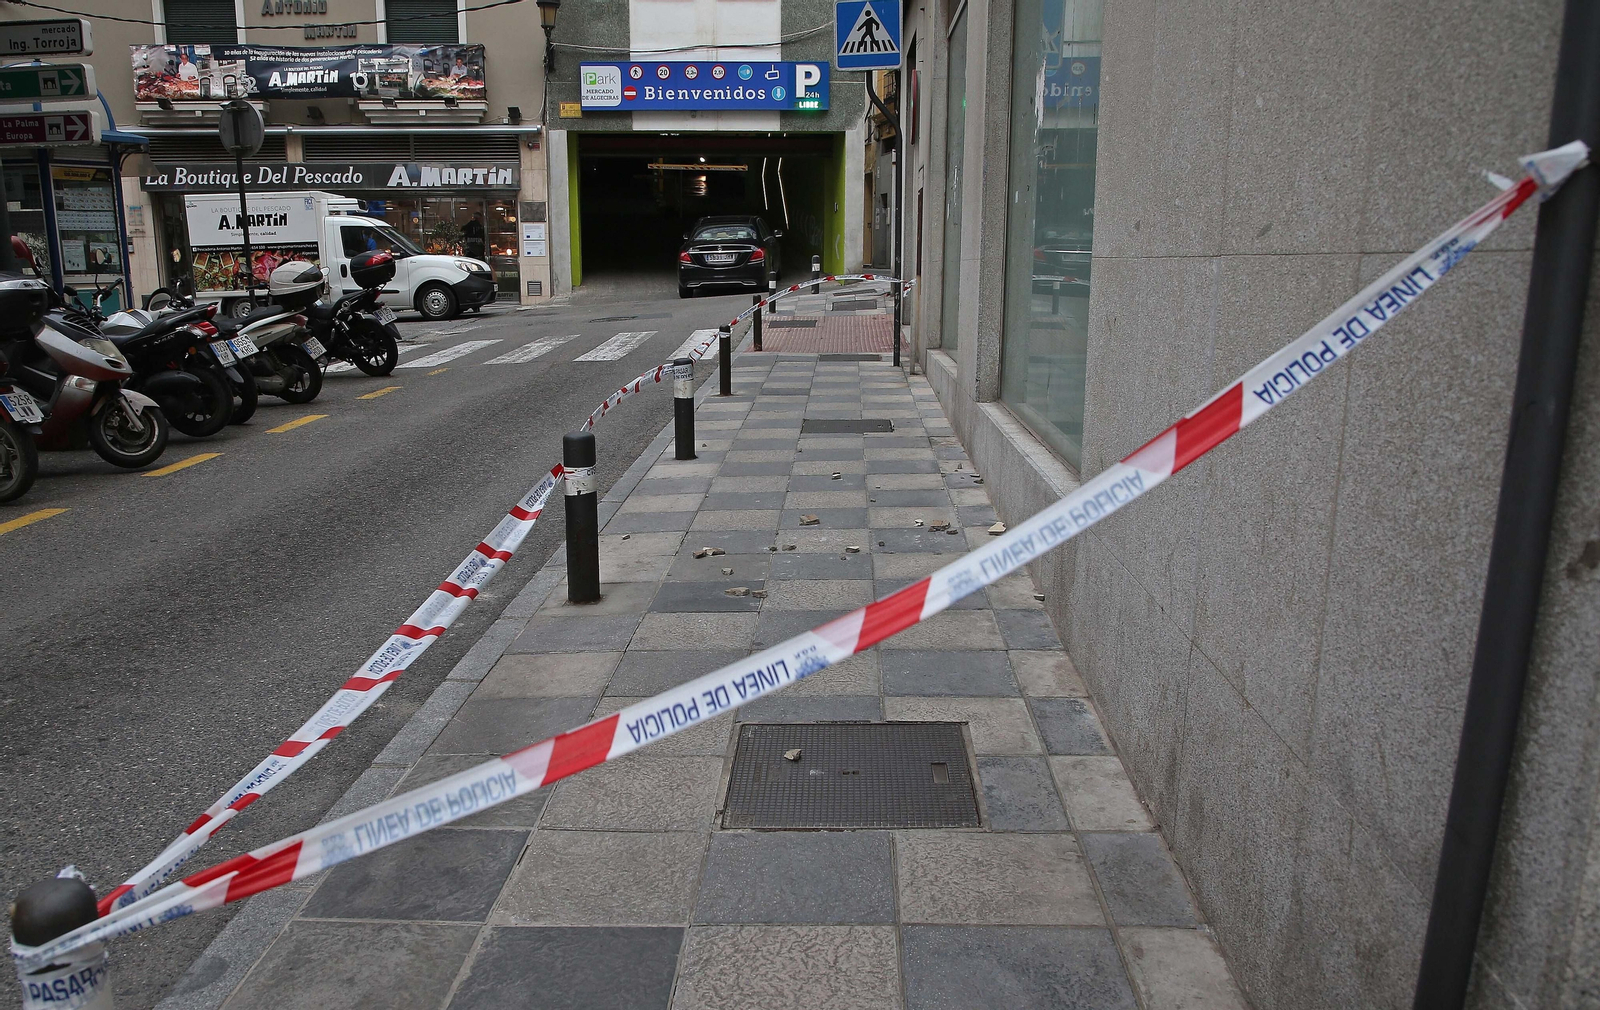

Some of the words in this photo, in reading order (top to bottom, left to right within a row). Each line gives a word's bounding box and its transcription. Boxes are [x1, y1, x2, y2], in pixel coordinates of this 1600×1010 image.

[42, 25, 76, 34] mercado
[9, 39, 30, 51] Ing.
[33, 37, 77, 50] Torroja
[583, 72, 616, 85] iPark
[644, 86, 766, 100] Bienvenidos
[6, 132, 33, 140] Europa
[174, 167, 252, 188] Boutique
[257, 166, 287, 184] Del
[293, 166, 363, 184] Pescado
[220, 206, 250, 214] BOUTIQE
[1364, 266, 1434, 321] LINEA
[1332, 316, 1370, 349] DE
[234, 336, 252, 347] 9553
[240, 345, 254, 355] KRG
[1253, 340, 1337, 405] POLICIA
[8, 395, 32, 406] 5258
[732, 659, 791, 700] LINEA
[702, 685, 730, 714] DE
[626, 696, 700, 744] POLICIA
[28, 967, 94, 1002] PASAR
